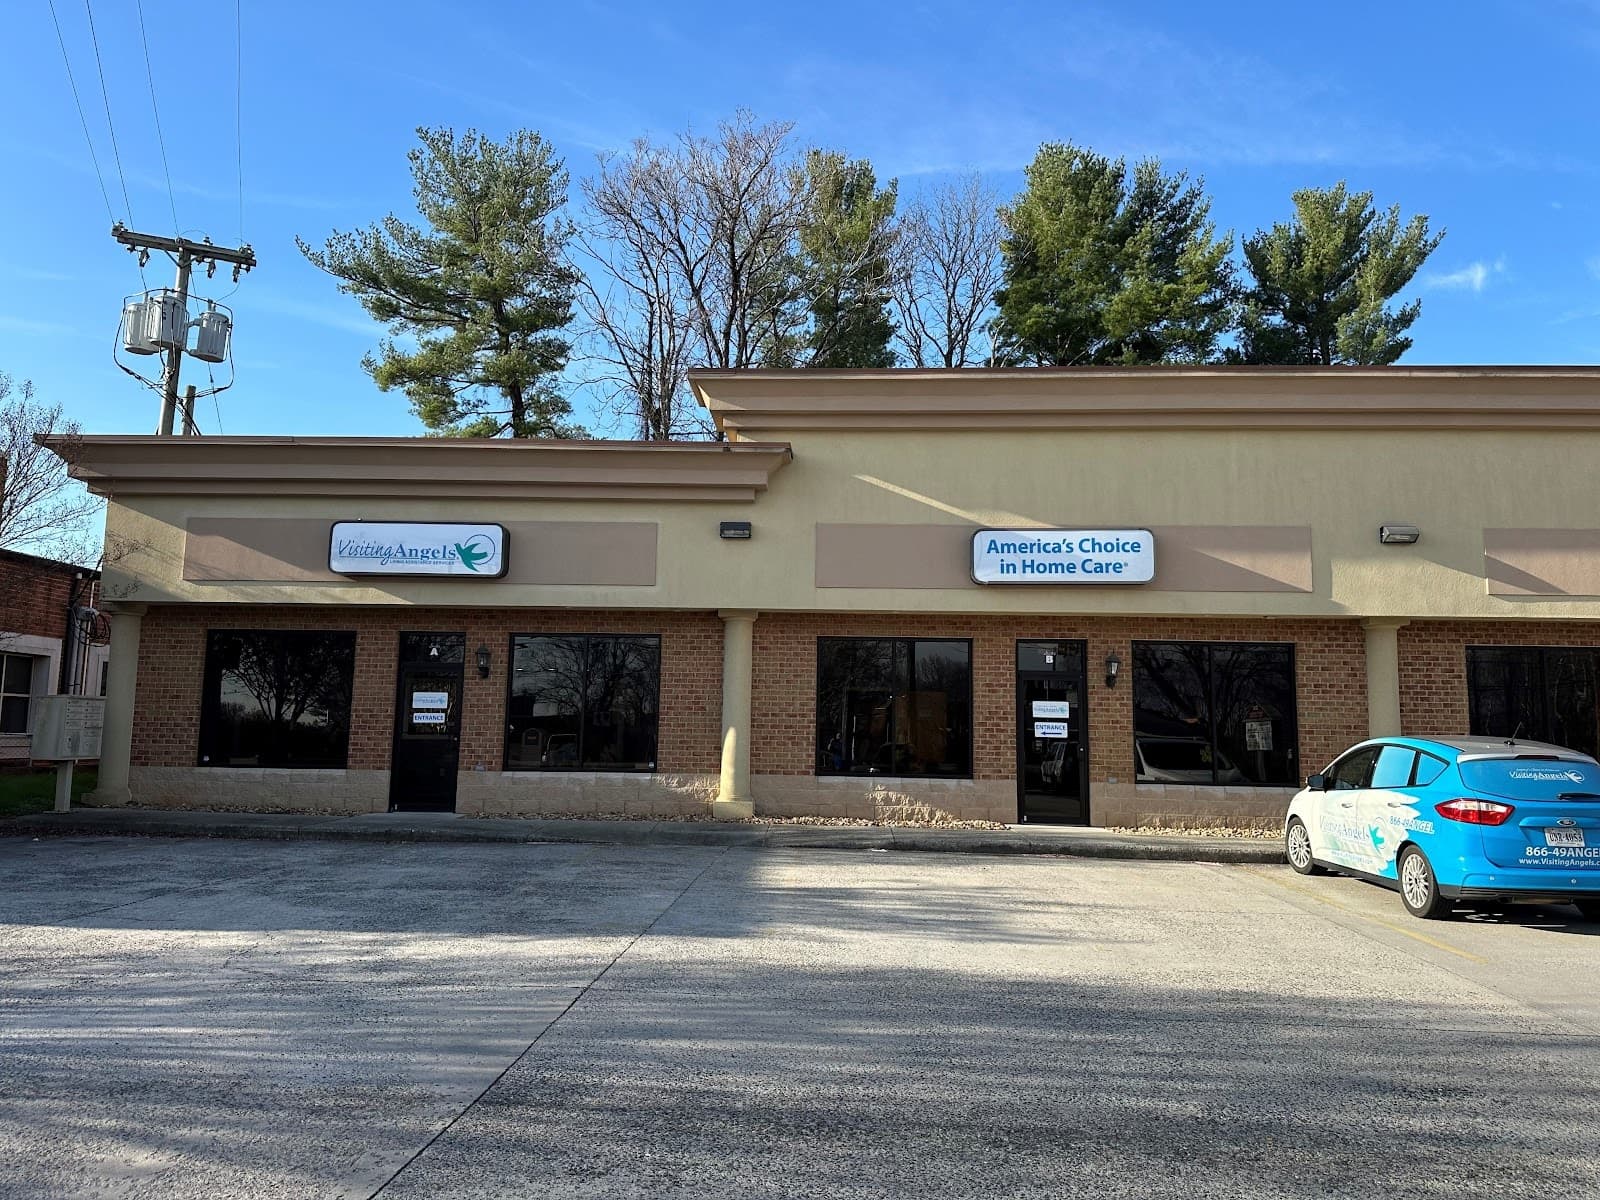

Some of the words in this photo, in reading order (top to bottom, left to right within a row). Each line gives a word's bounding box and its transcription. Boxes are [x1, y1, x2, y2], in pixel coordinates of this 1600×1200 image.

[987, 538, 1074, 554] America's
[1078, 537, 1141, 553] Choice
[1000, 558, 1017, 574] in
[1022, 559, 1077, 574] Home
